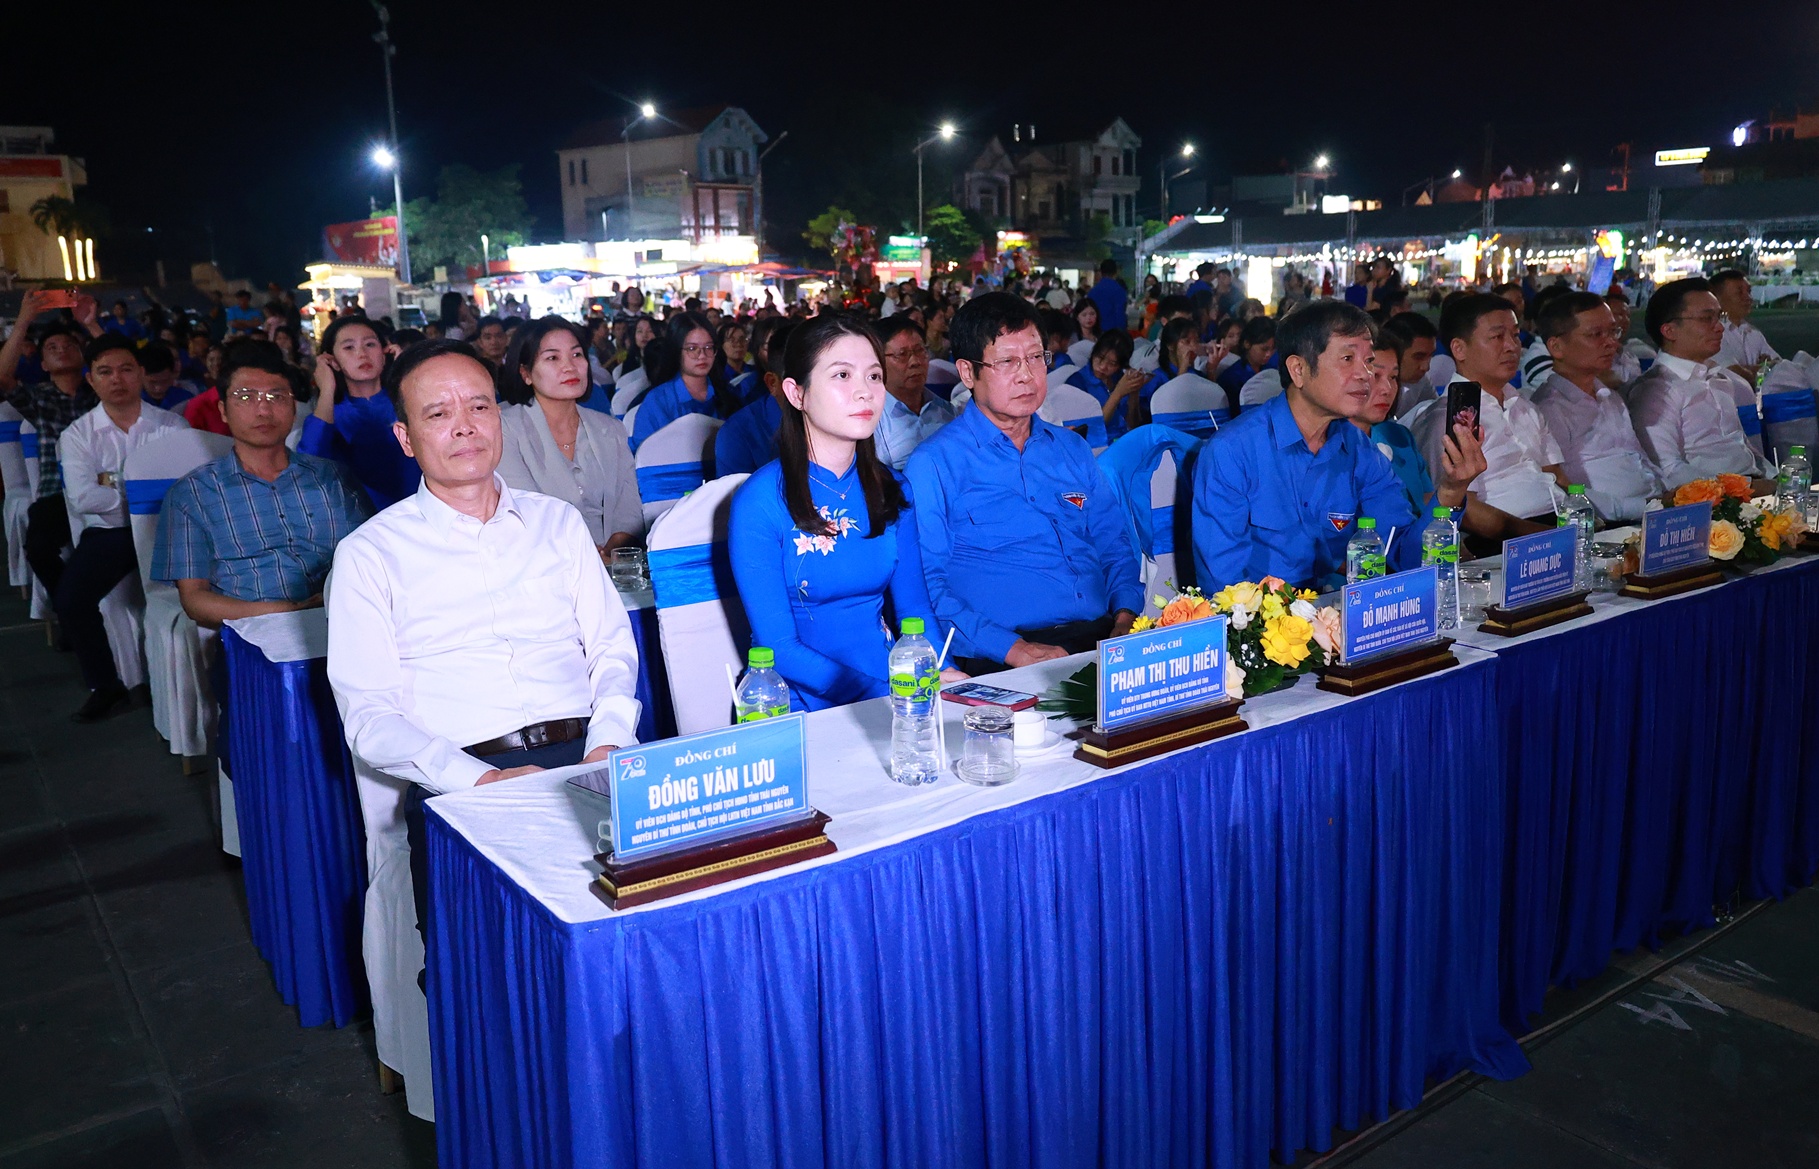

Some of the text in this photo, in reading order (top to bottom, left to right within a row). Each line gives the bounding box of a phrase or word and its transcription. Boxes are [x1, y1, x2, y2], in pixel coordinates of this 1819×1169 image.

[1528, 556, 1548, 577] QUANG
[1363, 596, 1420, 628] ĐỖ MẠNH HÙNG
[1142, 636, 1182, 655] ĐỒNG CHÍ
[1110, 644, 1218, 692] PHẠM THỊ THU HIỀN
[892, 678, 915, 687] dasani
[674, 742, 737, 767] ĐỒNG CHÍ
[648, 758, 775, 811] ĐỒNG VĂN LƯU
